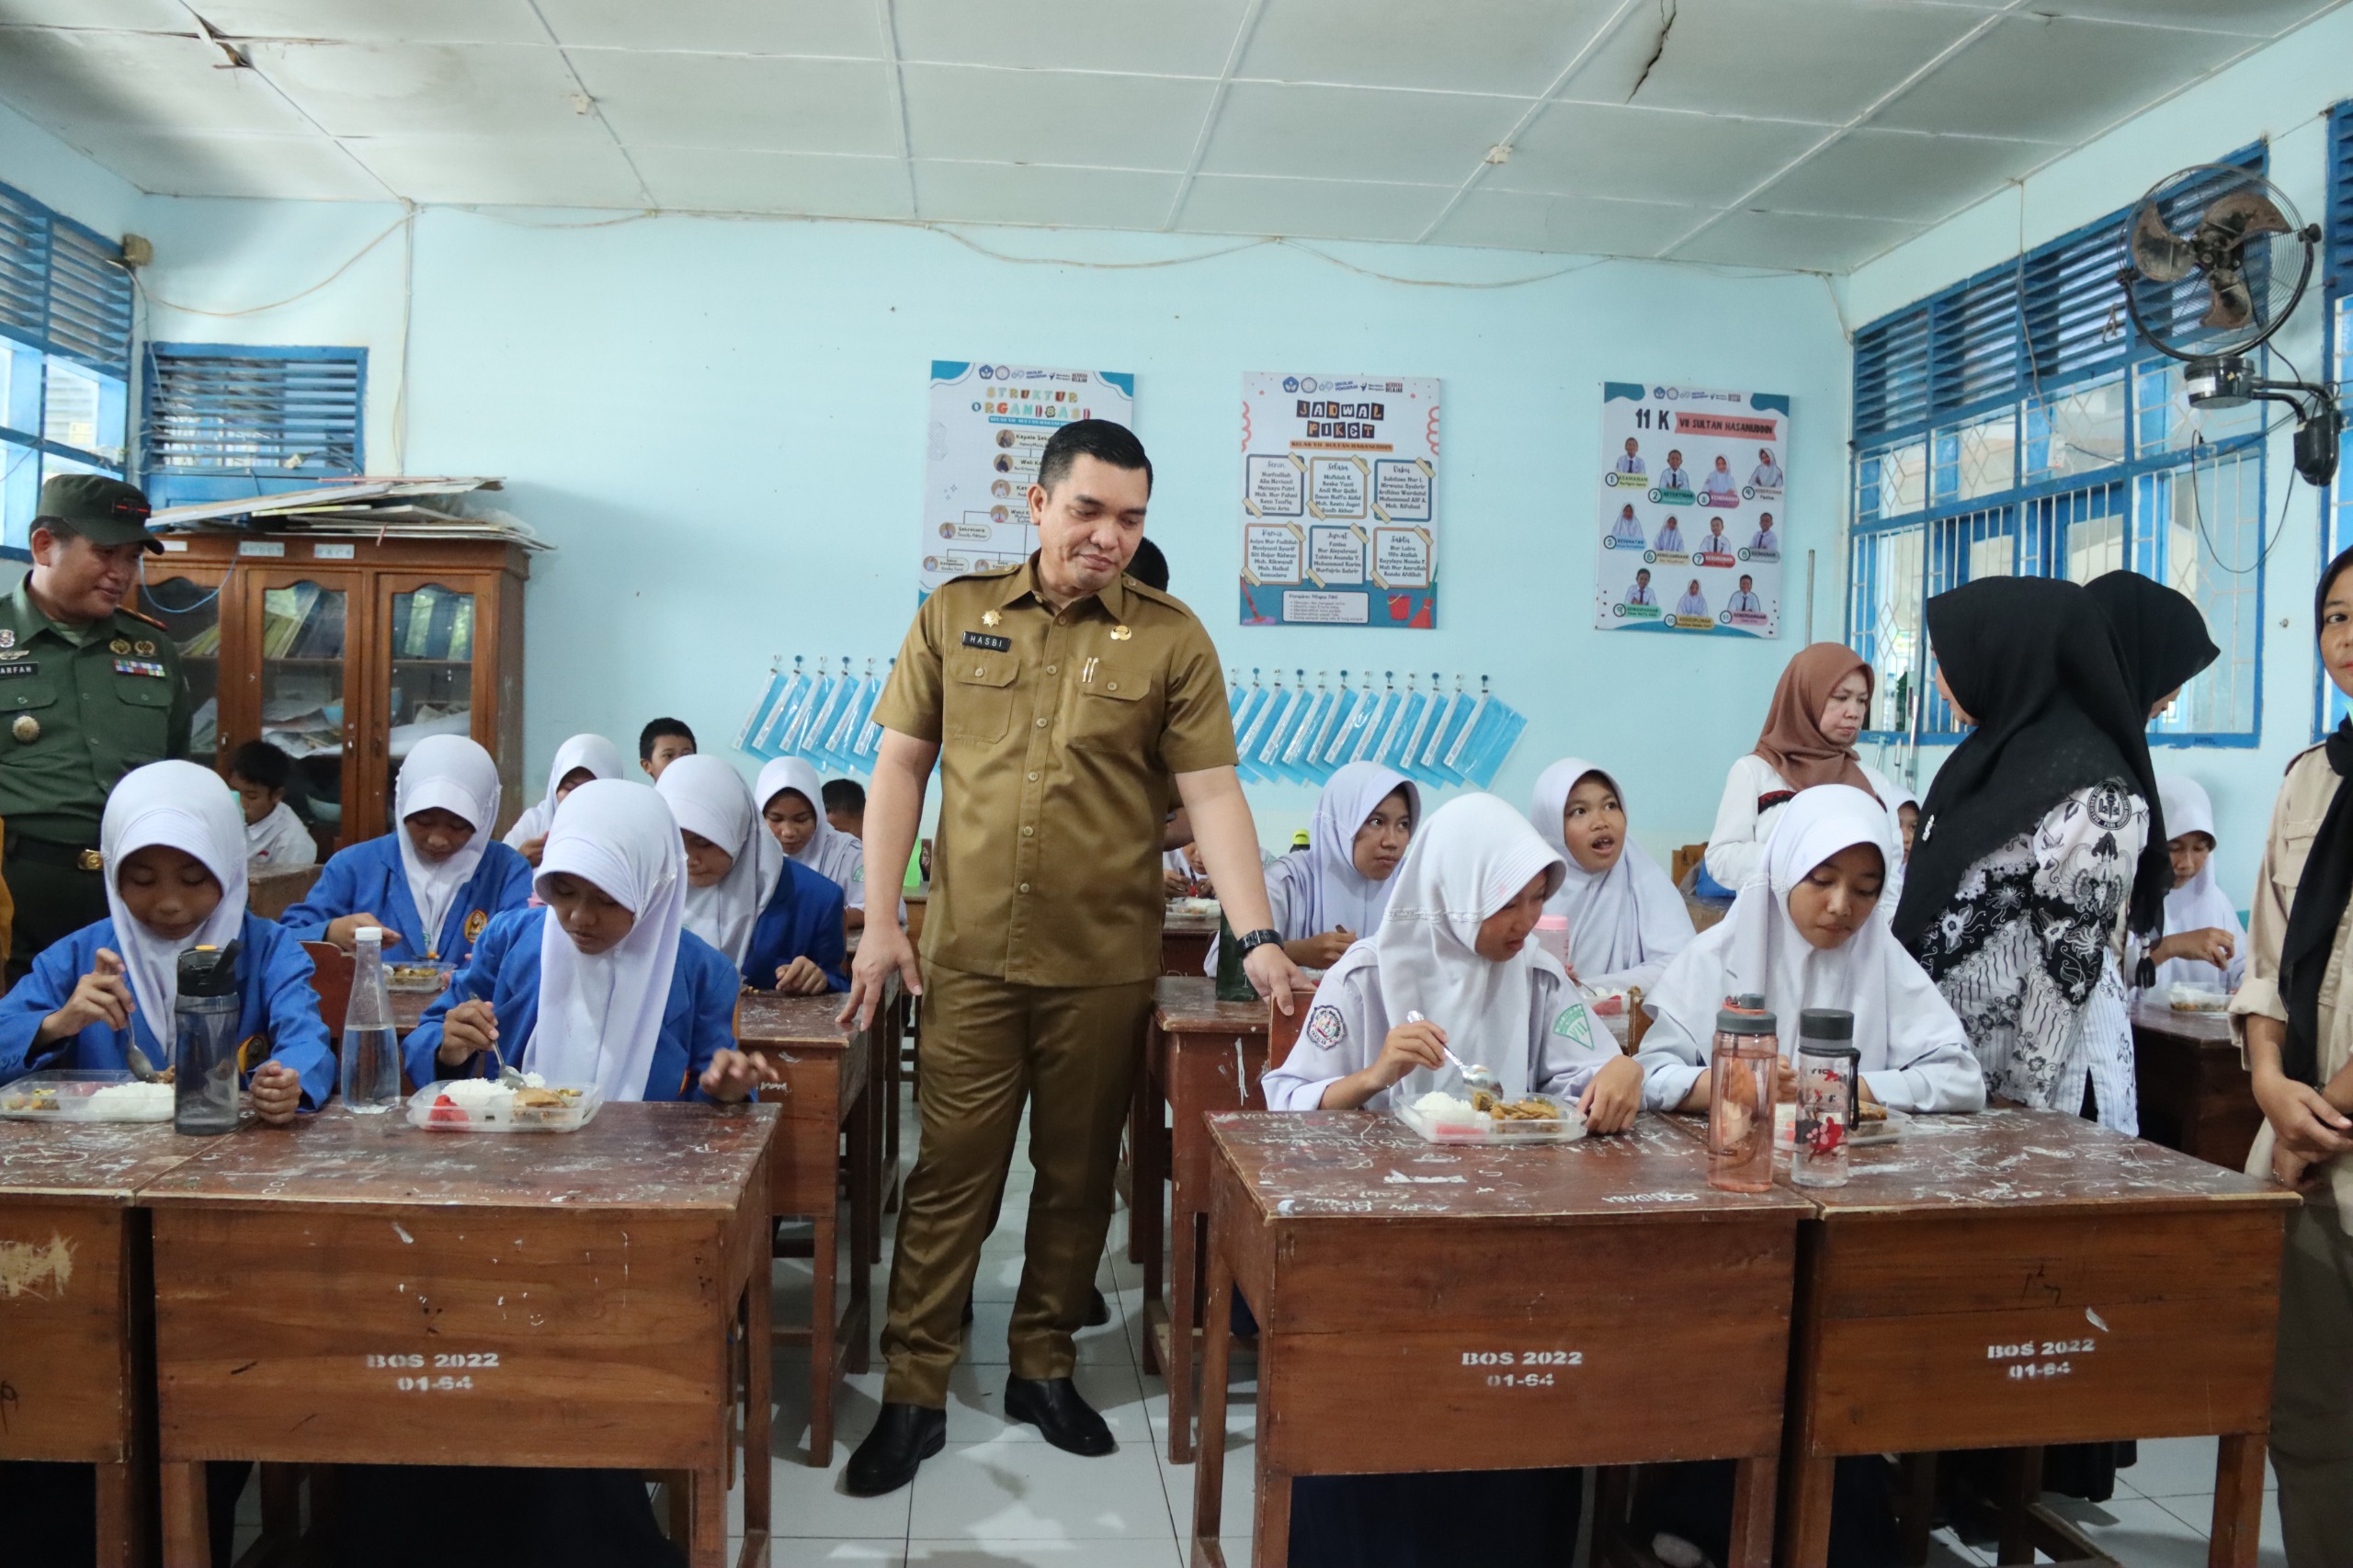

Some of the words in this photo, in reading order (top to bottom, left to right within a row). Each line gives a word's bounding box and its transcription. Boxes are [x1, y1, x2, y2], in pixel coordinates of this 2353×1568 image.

[986, 387, 1078, 403] STRUKTUR
[972, 402, 1091, 419] ORGANISASI
[1298, 401, 1383, 419] JADWAL
[1636, 408, 1651, 429] 11
[1658, 410, 1669, 430] K
[1679, 418, 1689, 427] VII
[1692, 419, 1722, 430] SULTAN
[1724, 422, 1772, 434] HASANUDDIN
[1308, 422, 1374, 437] PIKET
[970, 635, 1003, 648] HASBI
[1987, 1342, 2035, 1359] BOS
[2040, 1338, 2096, 1356] 2022
[368, 1354, 426, 1369] BOS
[434, 1353, 500, 1368] 2022
[1461, 1351, 1515, 1366] BOS
[1522, 1351, 1583, 1365] 2022
[1487, 1373, 1555, 1387] 01-64
